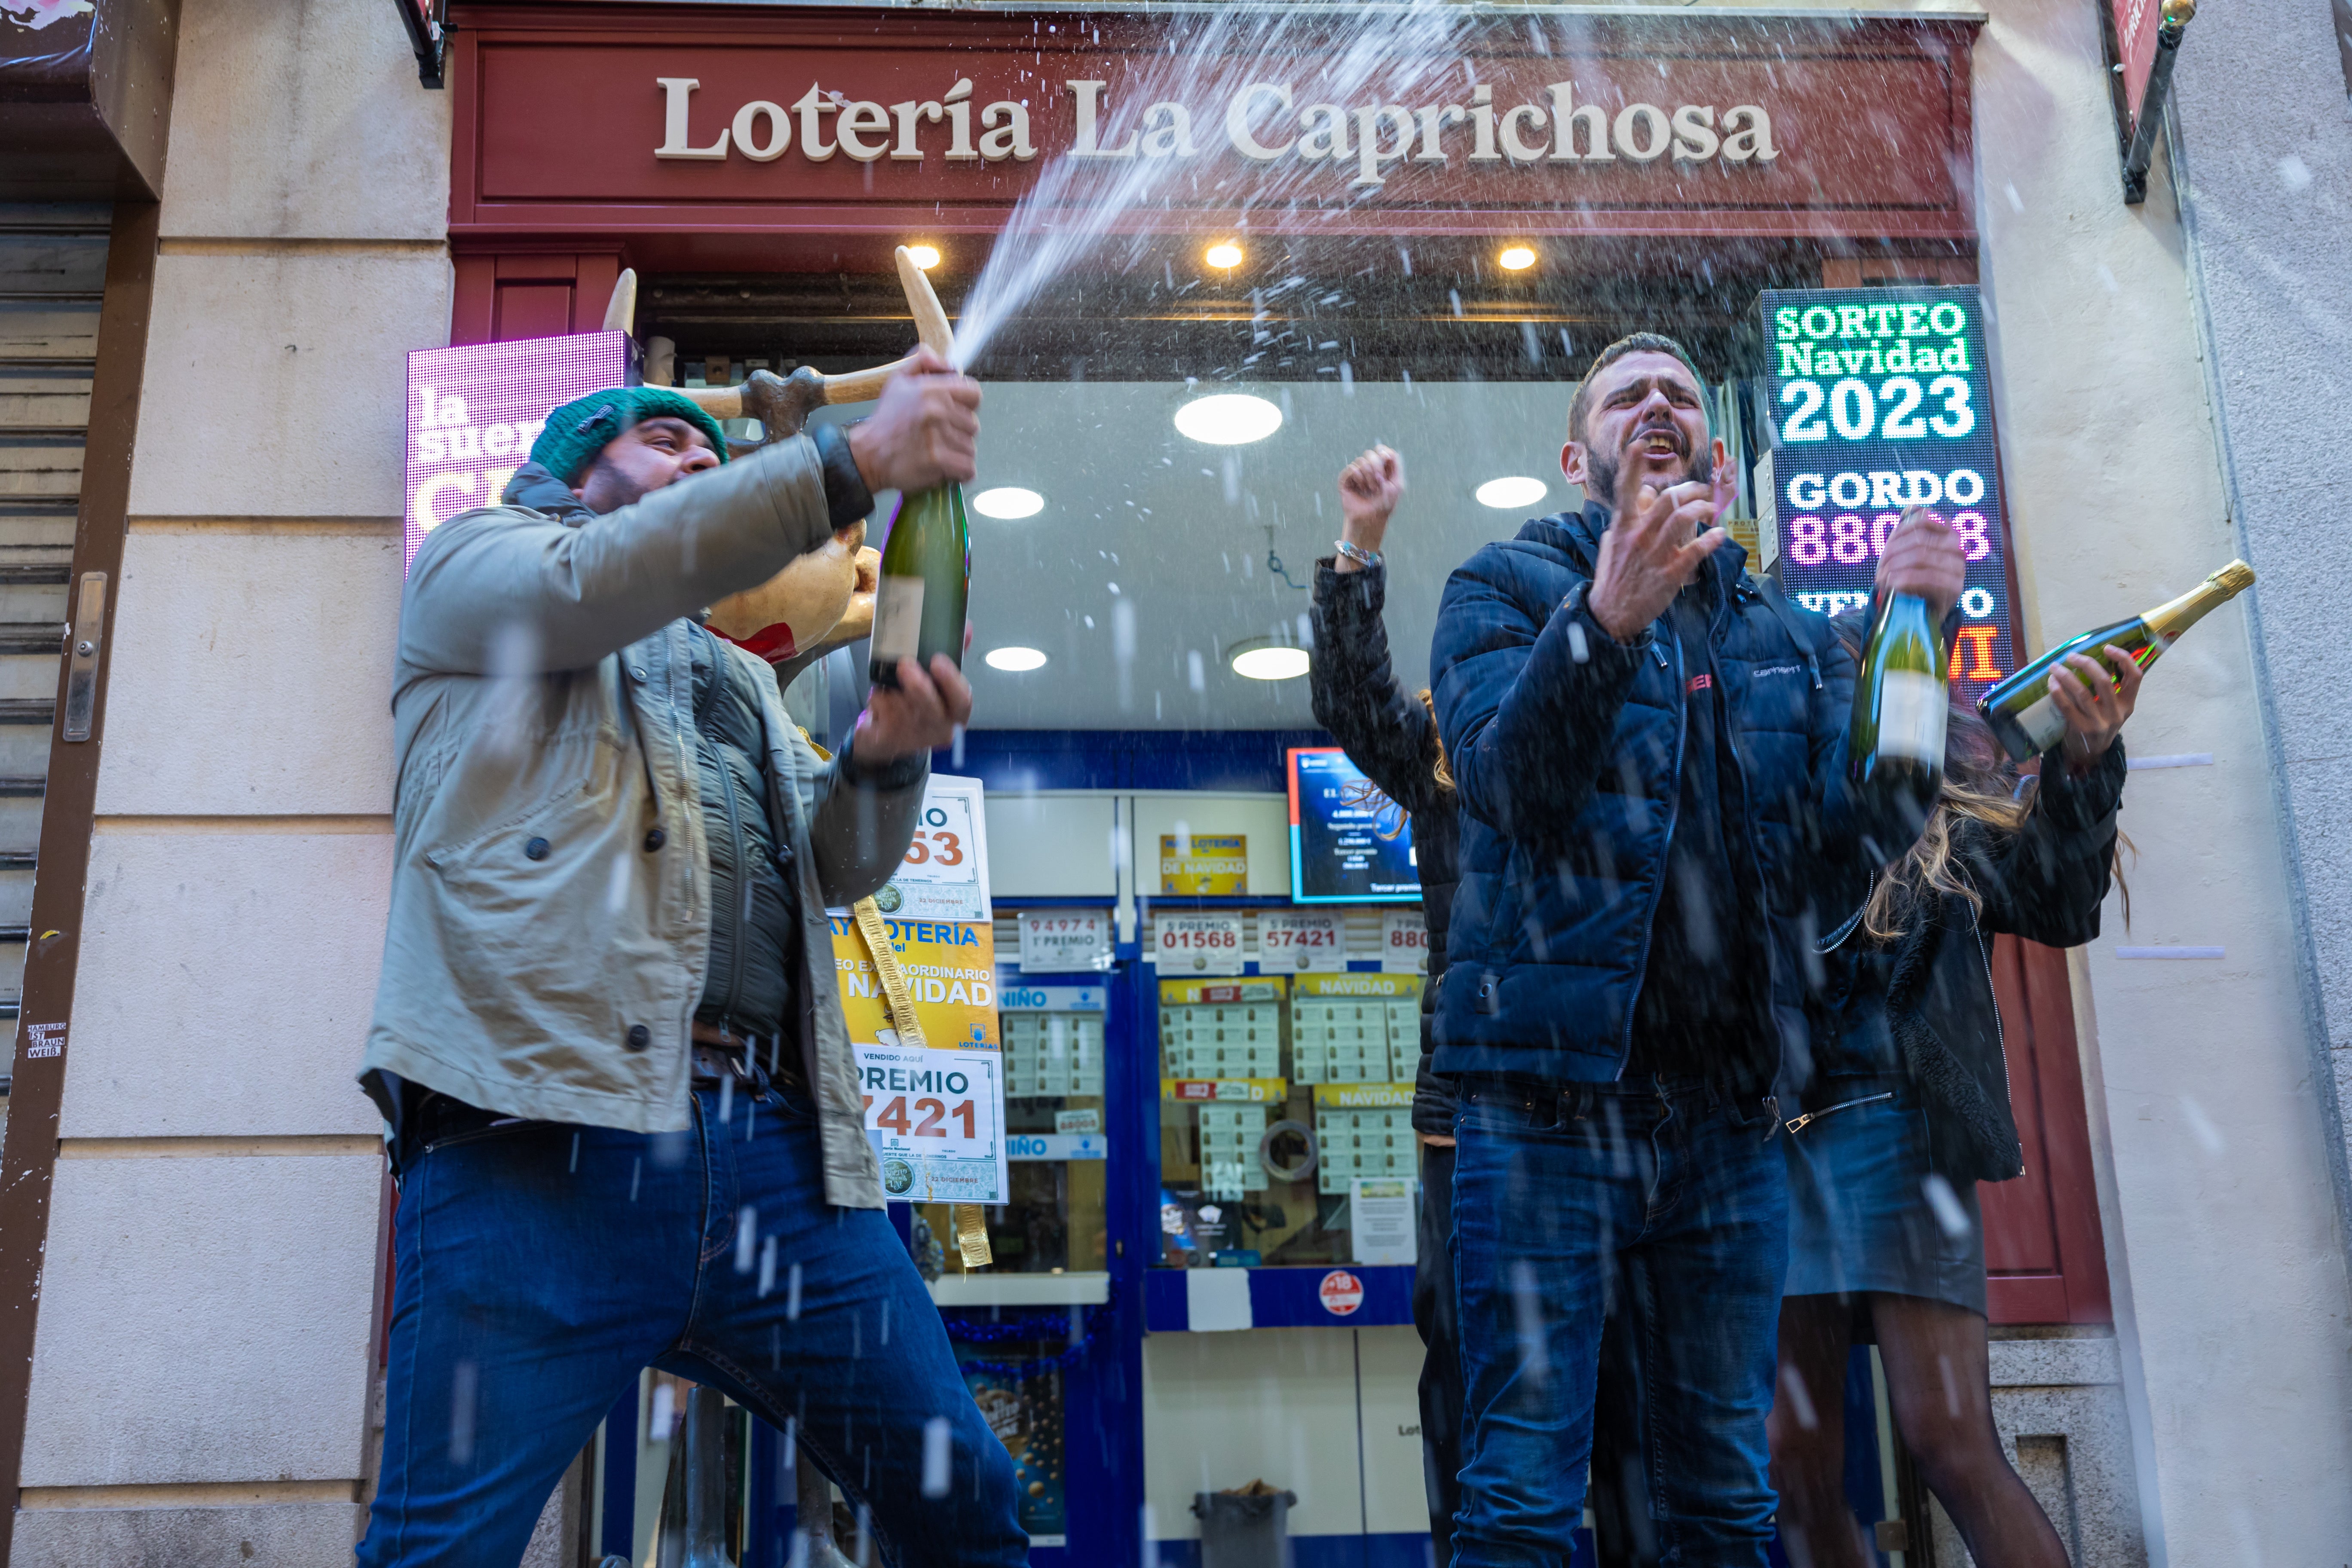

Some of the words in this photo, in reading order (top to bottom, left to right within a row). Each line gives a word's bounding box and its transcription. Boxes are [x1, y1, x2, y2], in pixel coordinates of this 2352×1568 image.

[654, 76, 1038, 162] Lotería
[1066, 79, 1193, 159] La
[1226, 78, 1780, 185] Caprichosa
[1776, 302, 1966, 340] SORTEO
[1777, 337, 1973, 376] Navidad
[1782, 375, 1975, 442] 2023
[1787, 469, 1986, 510] GORDO
[903, 831, 963, 866] 53
[1185, 861, 1246, 874] NAVIDAD
[1044, 935, 1095, 946] PREMIO
[1163, 931, 1236, 949] 01568
[1267, 930, 1335, 947] 57421
[1319, 980, 1396, 995] NAVIDAD
[28, 1023, 66, 1031] HAMBURG
[33, 1038, 64, 1048] BRAUN
[864, 1053, 900, 1061] VENDIDO
[1339, 1091, 1414, 1106] NAVIDAD
